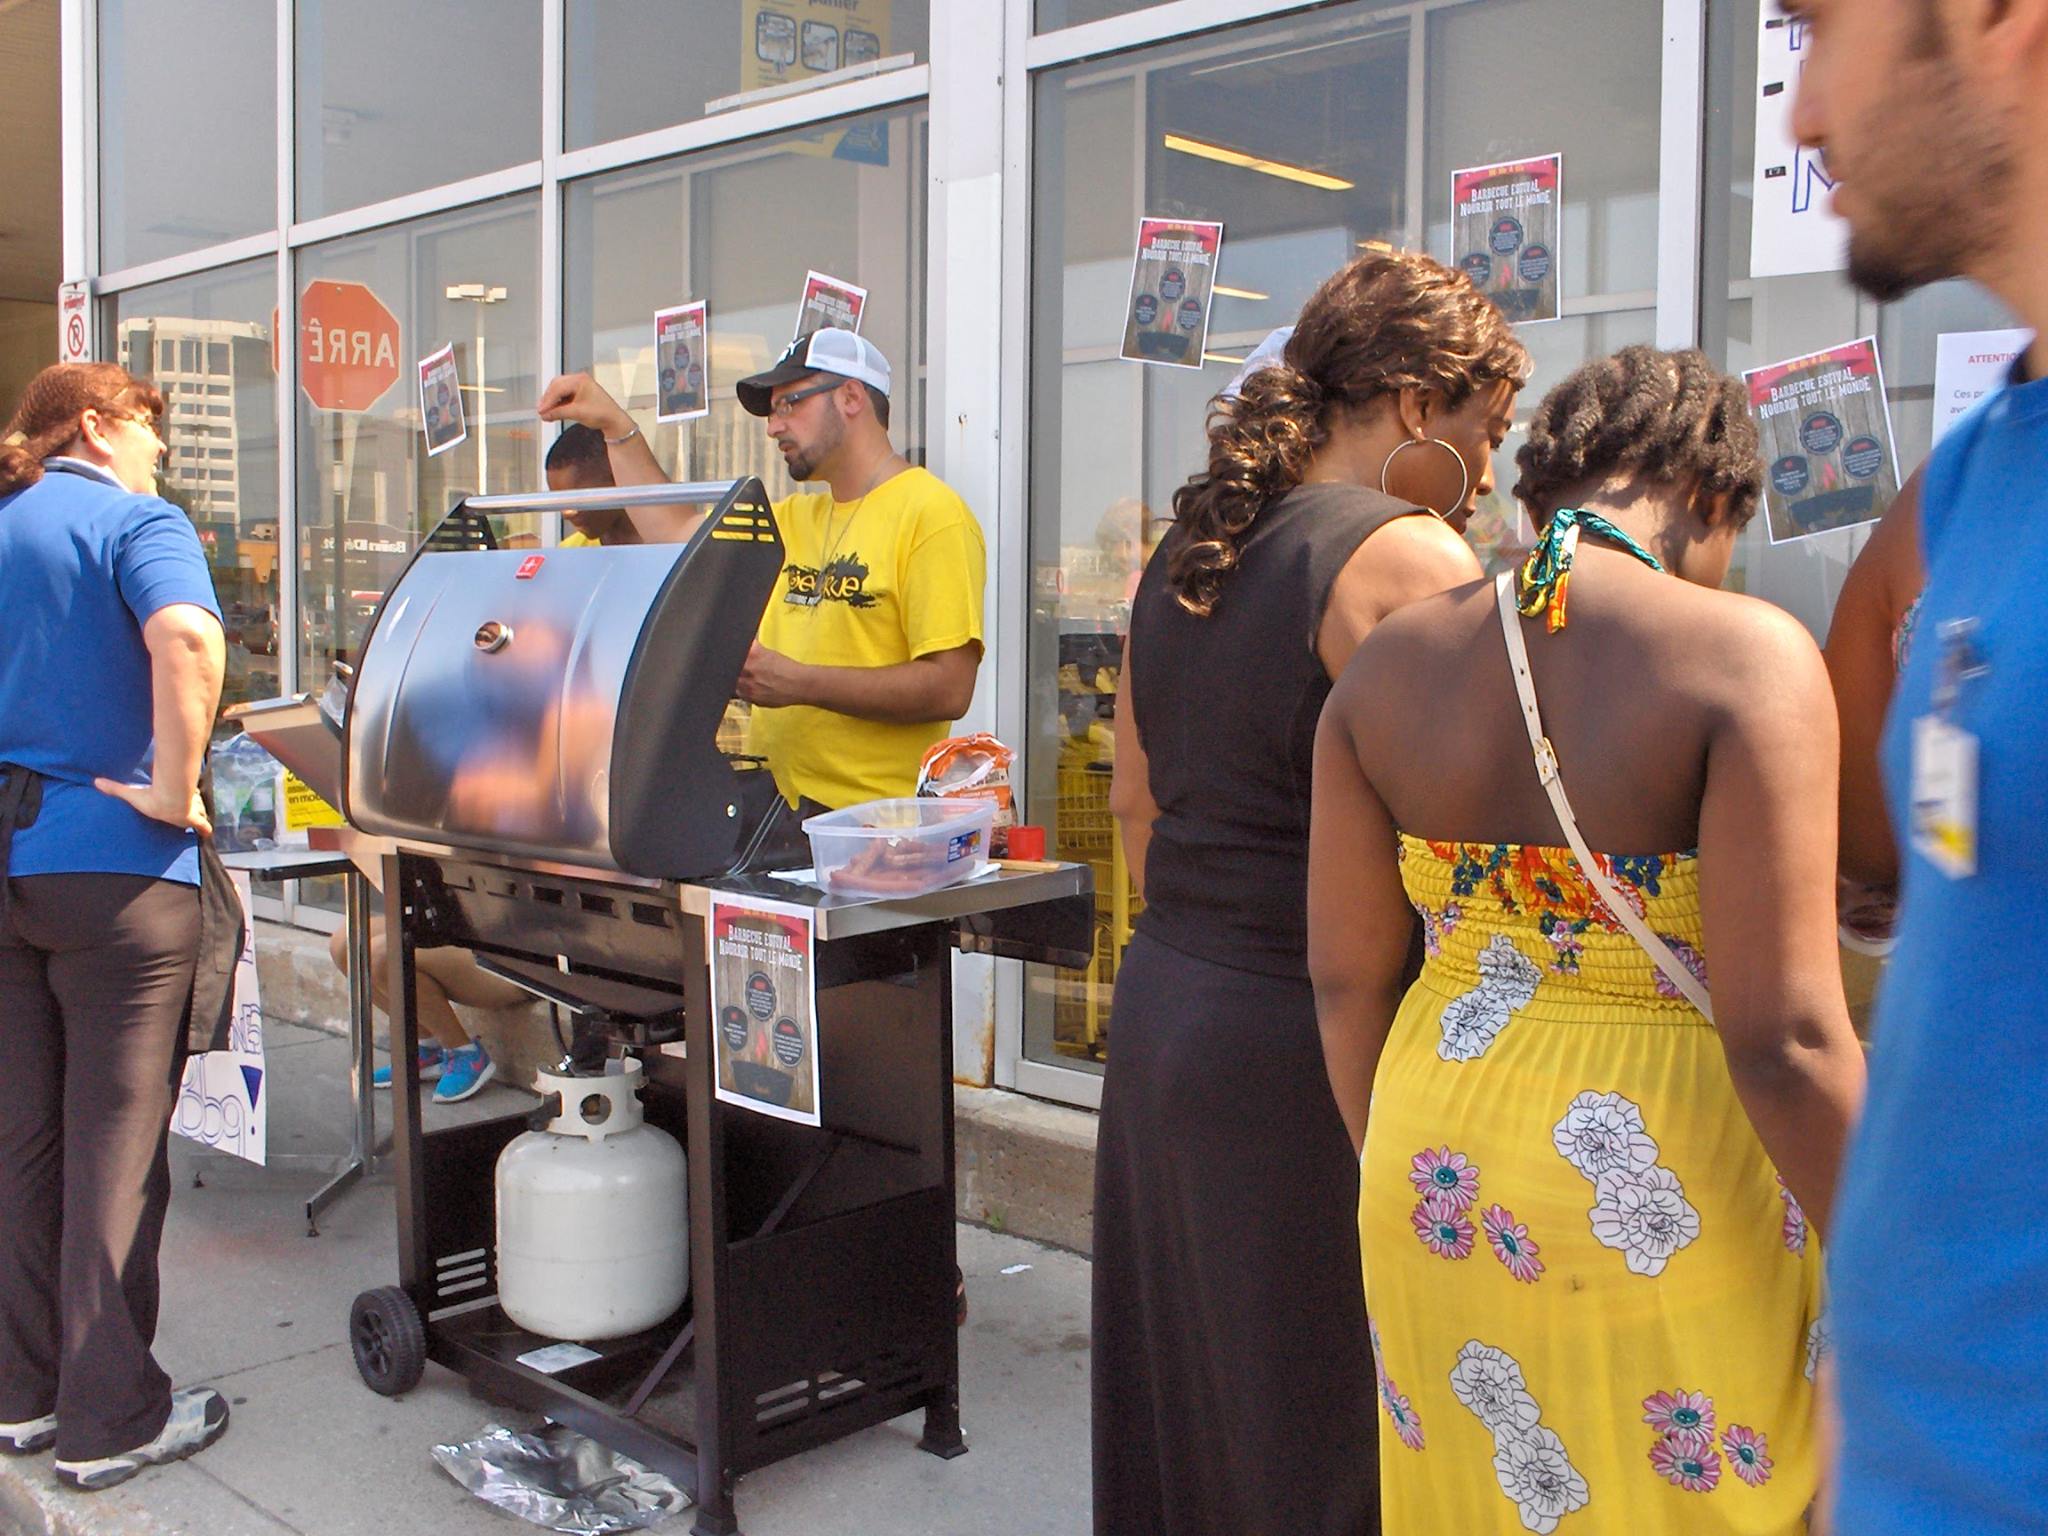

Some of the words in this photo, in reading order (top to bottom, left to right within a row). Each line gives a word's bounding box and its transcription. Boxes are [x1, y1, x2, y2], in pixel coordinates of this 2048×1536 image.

[1968, 352, 2019, 364] ATTENTIO
[1760, 395, 1799, 420] NOURRIR
[1801, 391, 1823, 407] TOUT
[1825, 387, 1836, 401] LE
[1838, 376, 1872, 398] MONDE
[1771, 378, 1815, 402] BARBECUE
[1817, 366, 1855, 387] ESTIVAL
